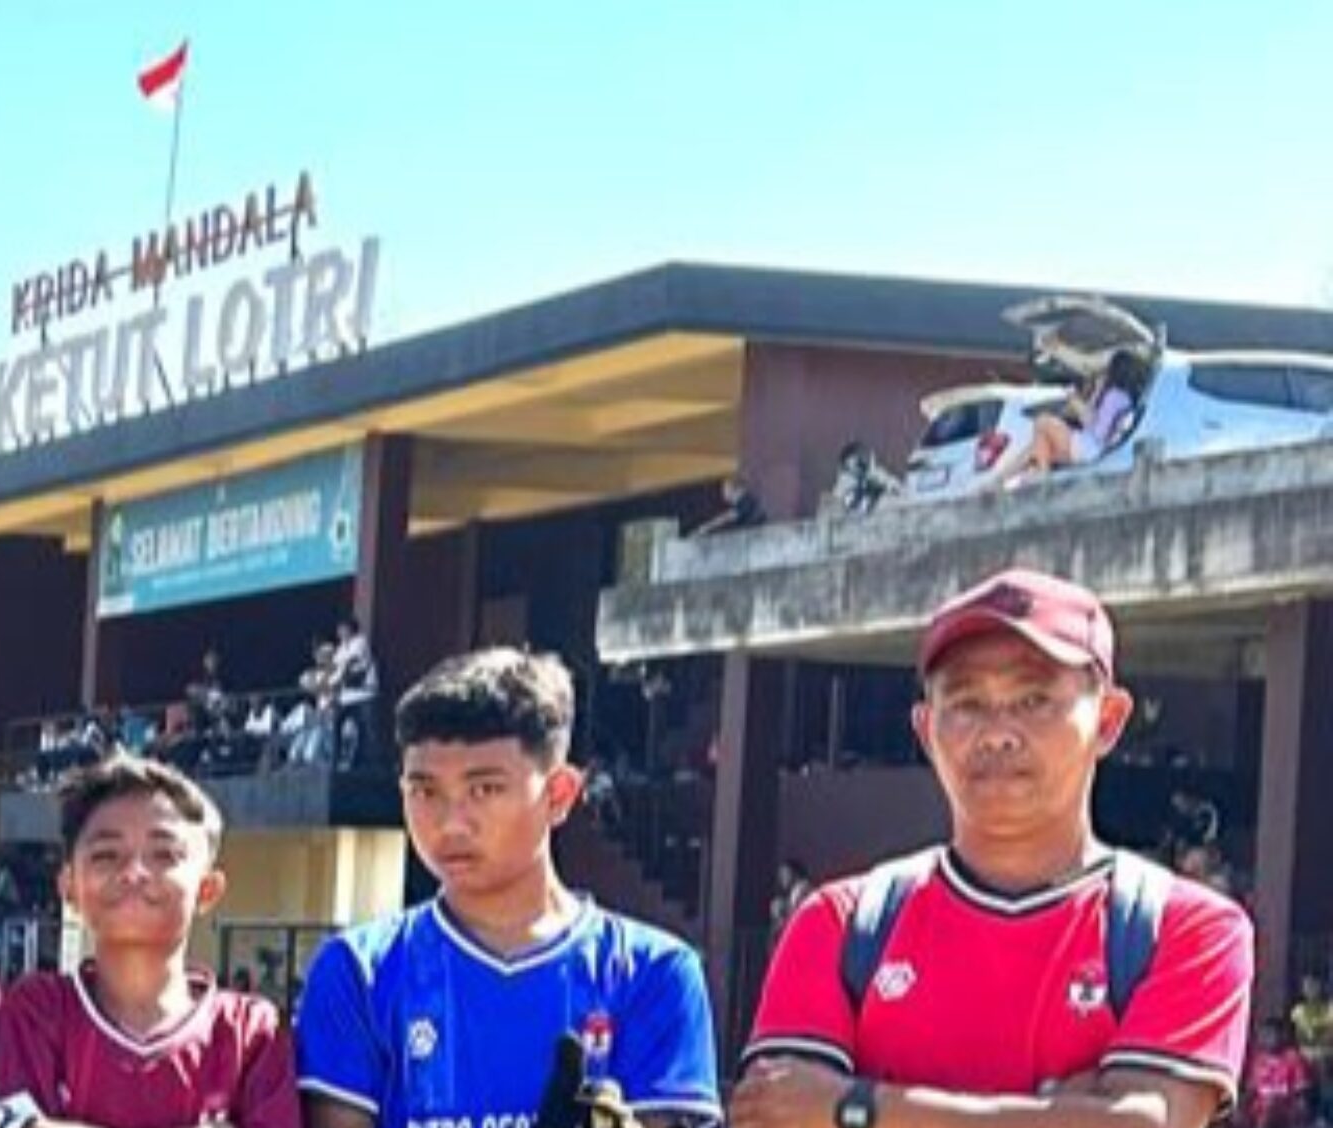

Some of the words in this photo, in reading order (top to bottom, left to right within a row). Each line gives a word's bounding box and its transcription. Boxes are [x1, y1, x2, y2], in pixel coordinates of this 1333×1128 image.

[10, 249, 113, 335] KRIDA
[131, 169, 318, 289] MANDALA
[181, 235, 381, 397] LOTRI
[129, 515, 204, 575] SELAMAT
